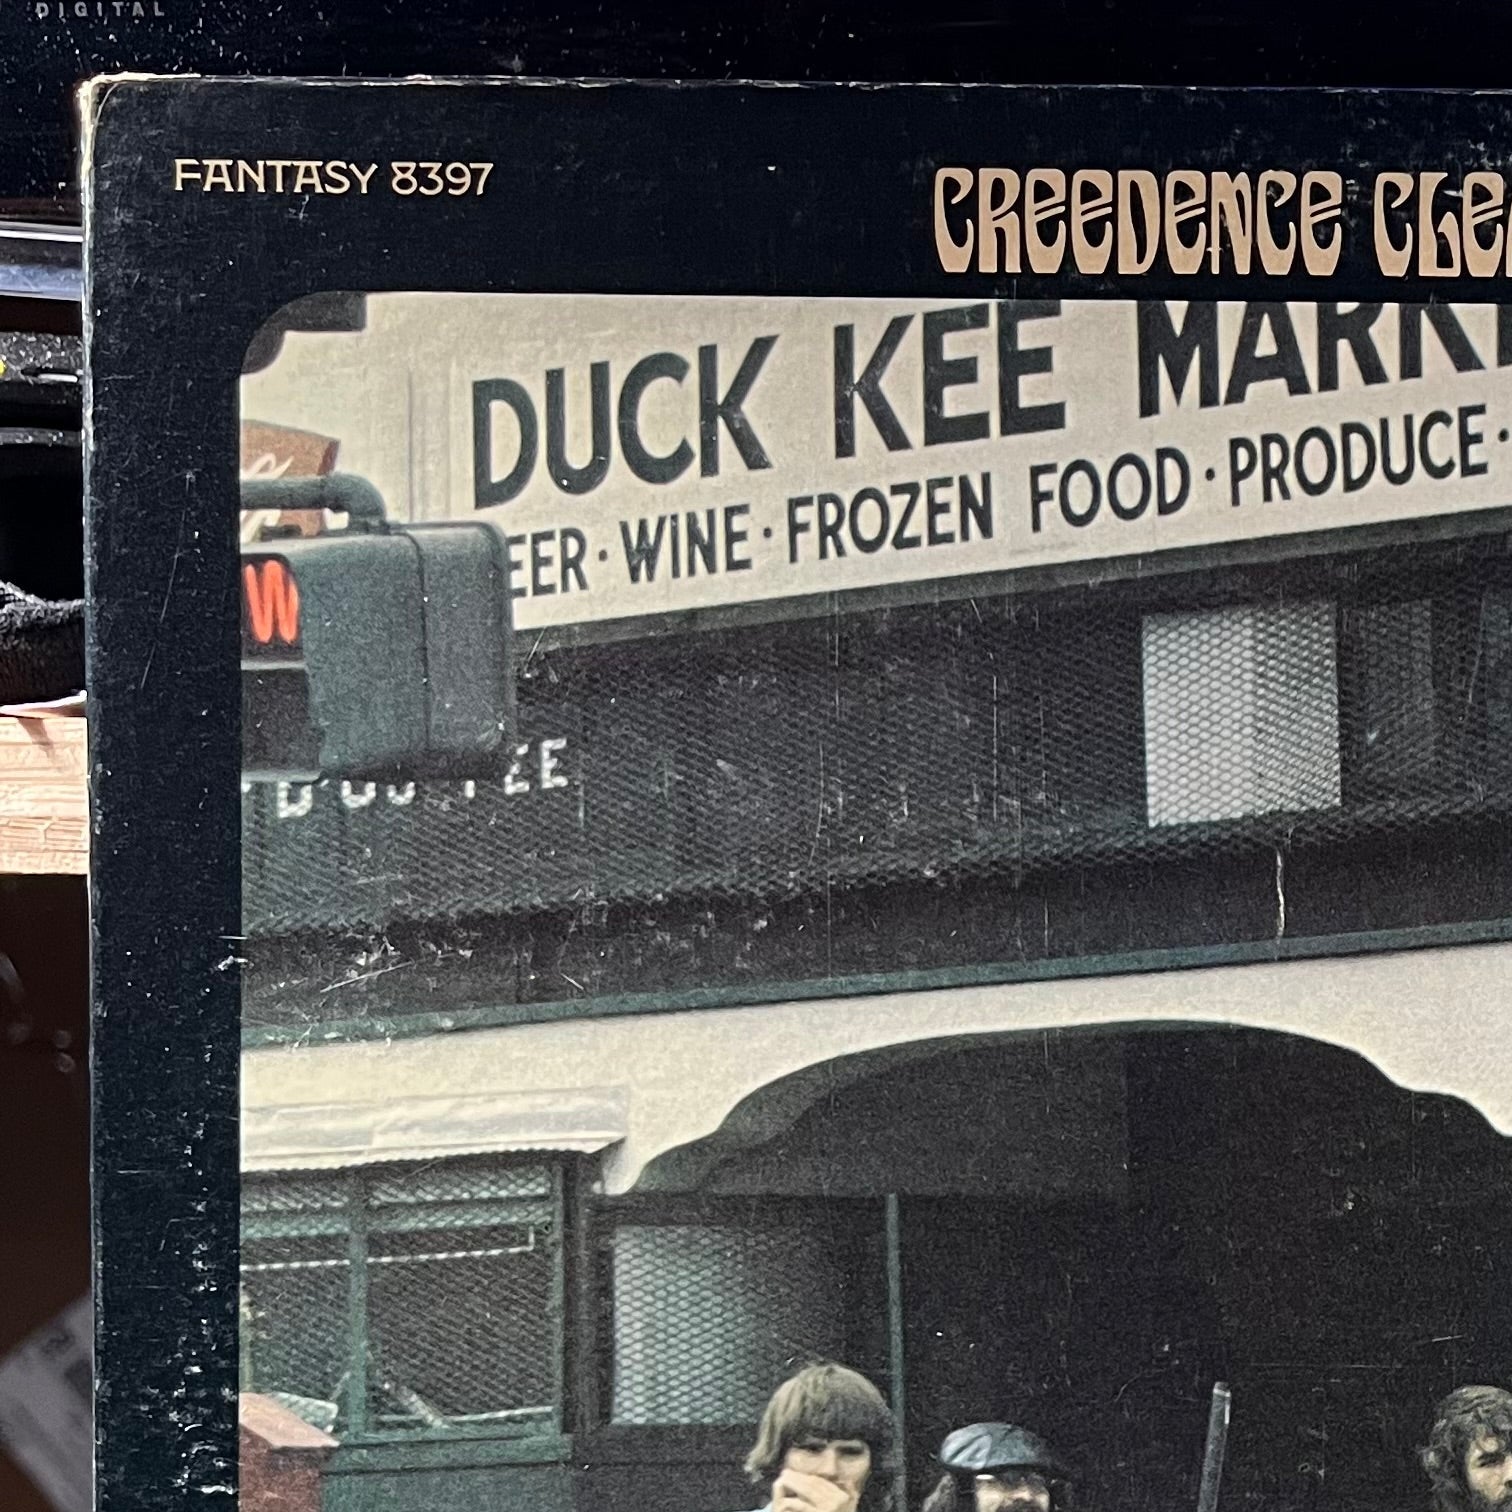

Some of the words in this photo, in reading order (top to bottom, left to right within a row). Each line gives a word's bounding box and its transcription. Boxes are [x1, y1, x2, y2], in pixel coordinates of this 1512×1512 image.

[35, 1, 165, 18] DIGITAL
[174, 158, 379, 194] FANTASY
[391, 161, 494, 196] 8397
[933, 167, 1343, 275] CREEDENCE
[472, 333, 781, 511] DUCK
[833, 302, 1066, 459] KEE
[619, 504, 752, 585] WINE
[788, 472, 993, 563] FROZEN
[1030, 447, 1190, 533] FOOD
[1229, 403, 1489, 506] PRODUCE
